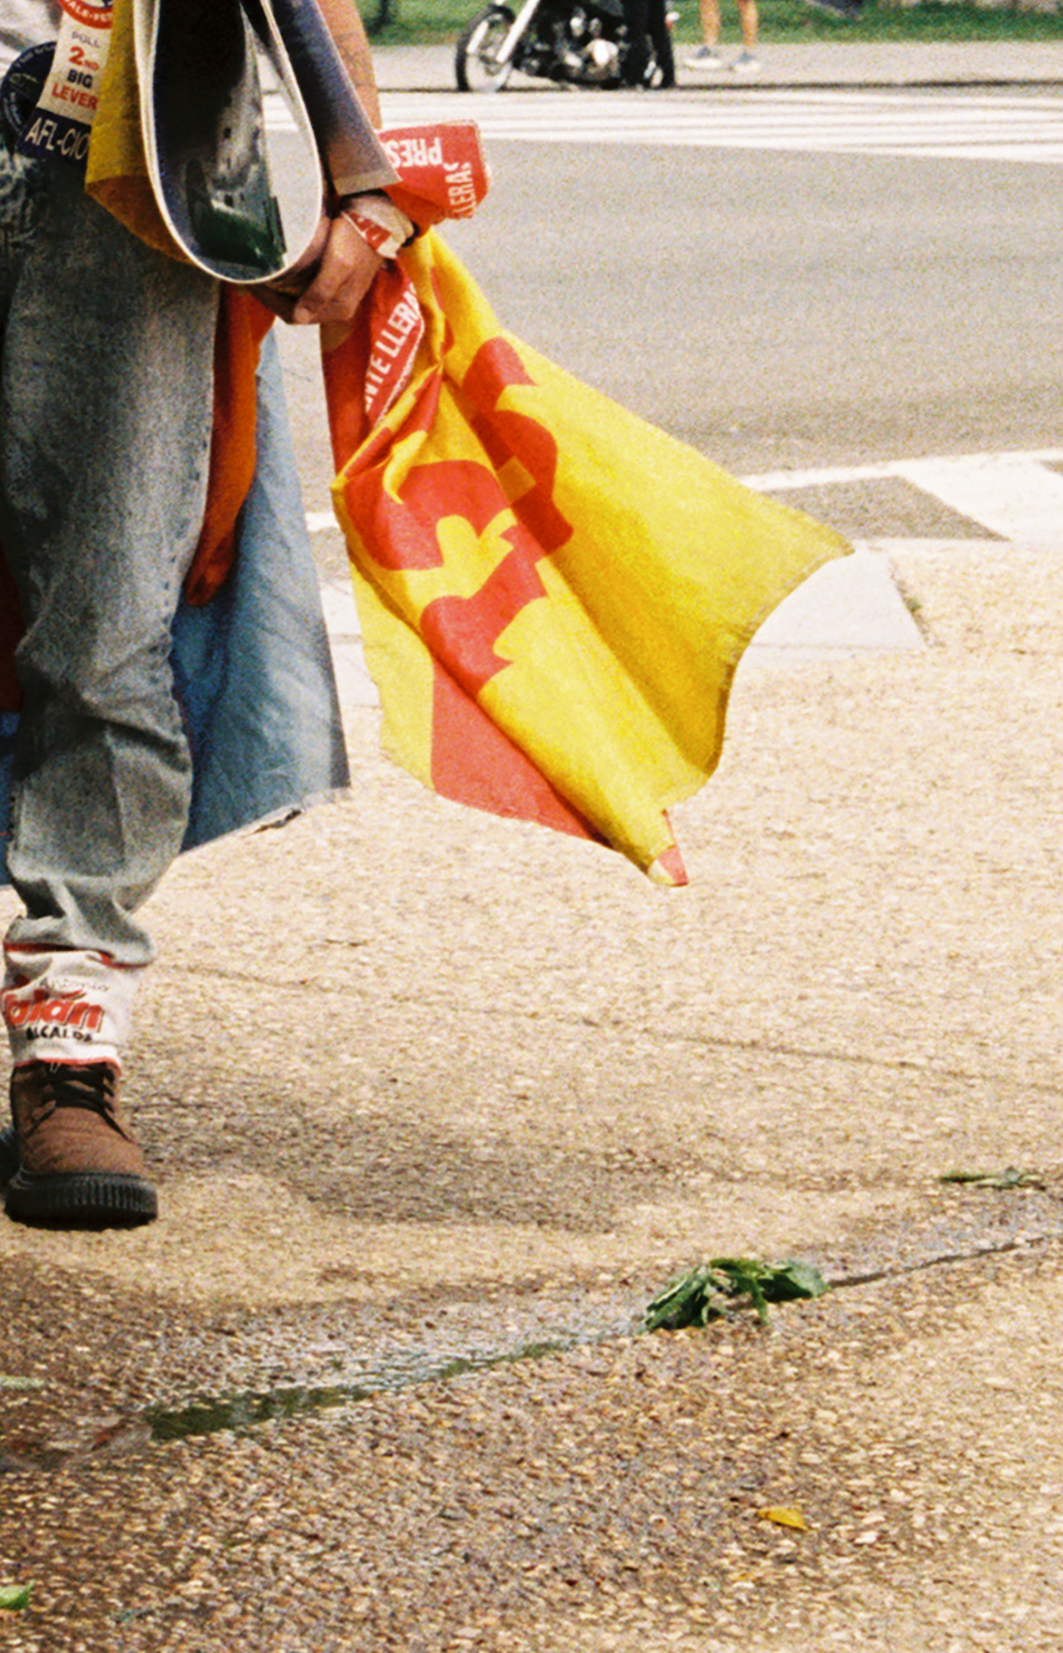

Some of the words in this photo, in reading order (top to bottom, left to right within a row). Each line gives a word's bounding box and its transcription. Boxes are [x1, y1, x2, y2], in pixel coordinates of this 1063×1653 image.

[68, 46, 100, 72] 2ND
[66, 69, 94, 89] BIG
[51, 83, 99, 110] LEVER
[385, 137, 443, 168] PRES
[374, 282, 422, 359] LLERA
